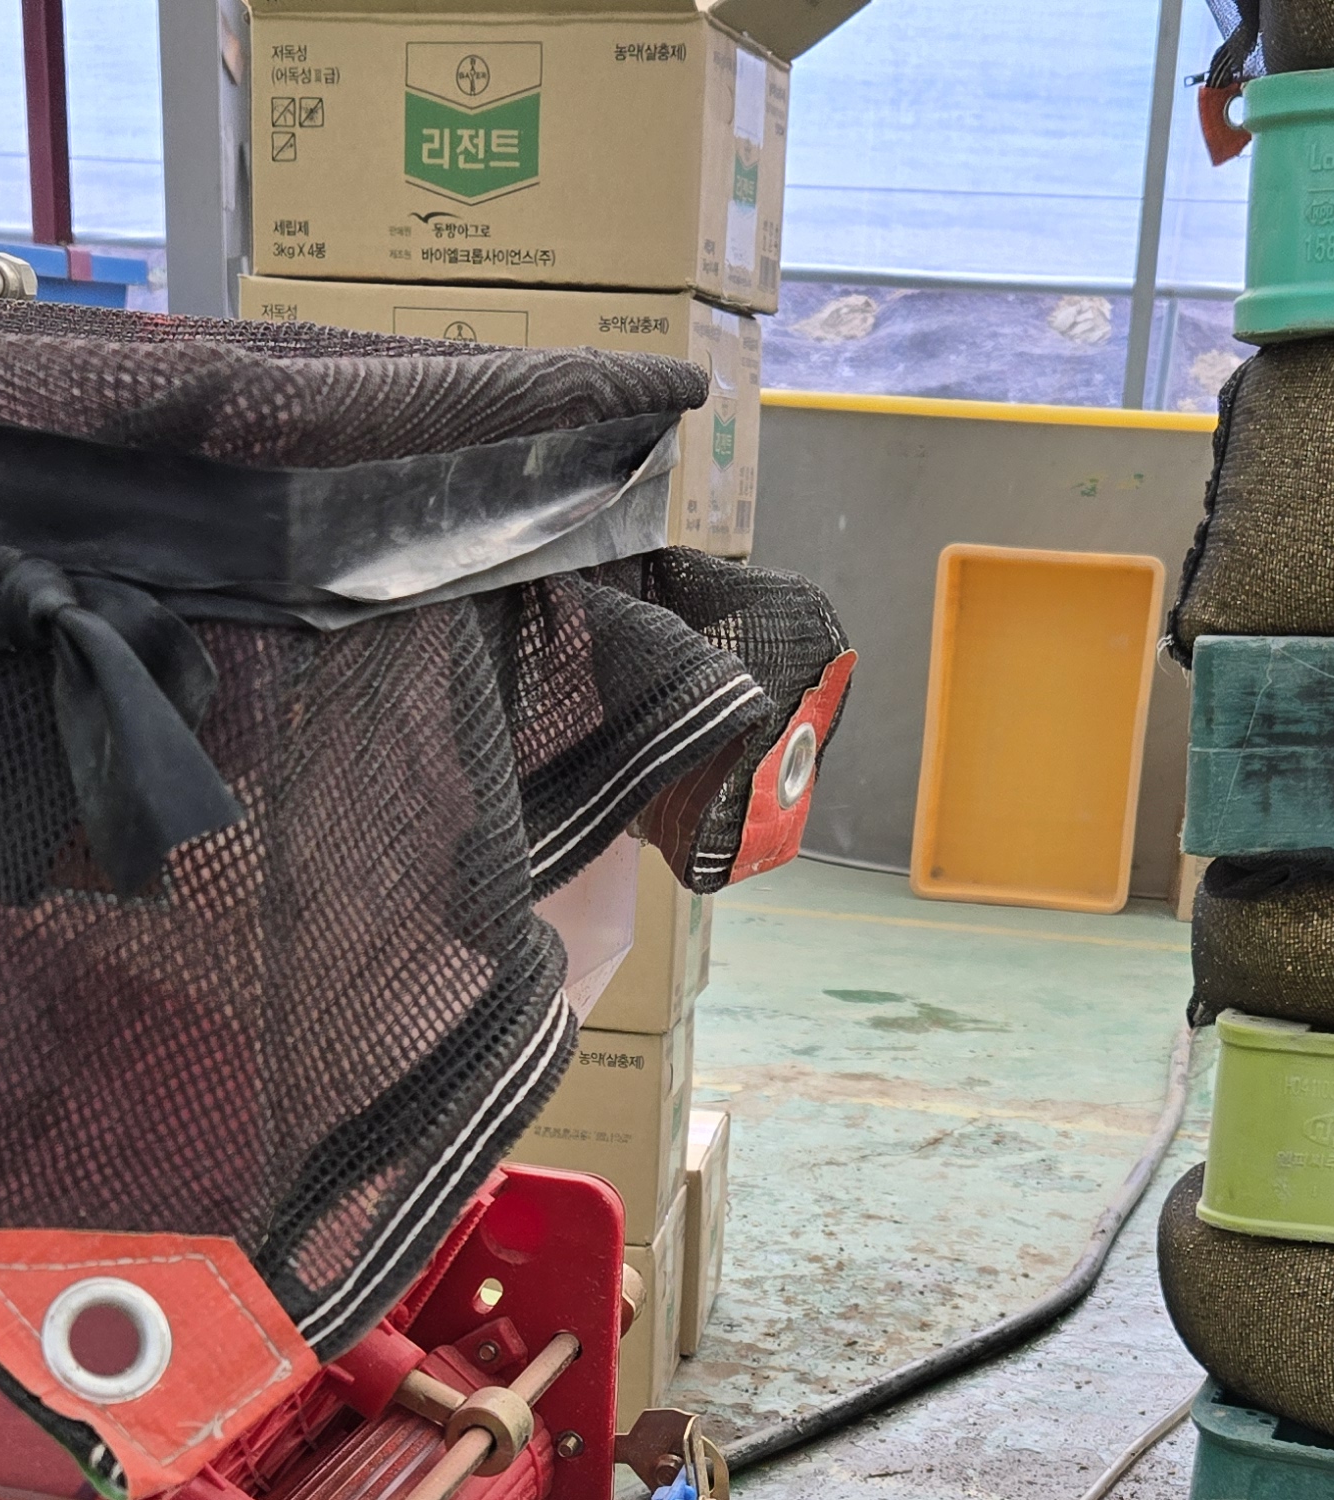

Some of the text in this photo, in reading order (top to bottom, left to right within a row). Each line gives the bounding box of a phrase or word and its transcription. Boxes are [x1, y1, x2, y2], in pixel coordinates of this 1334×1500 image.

[271, 45, 307, 62] 저독성
[614, 43, 687, 62] 농약(살충제)
[421, 128, 520, 169] 리전트
[273, 220, 310, 237] 세립제
[432, 224, 491, 239] 동방아그로
[273, 243, 295, 259] 3kg
[261, 304, 298, 319] 저독성
[598, 316, 669, 334] 농약(살충제)
[579, 1050, 644, 1071] 농약(살충제)
